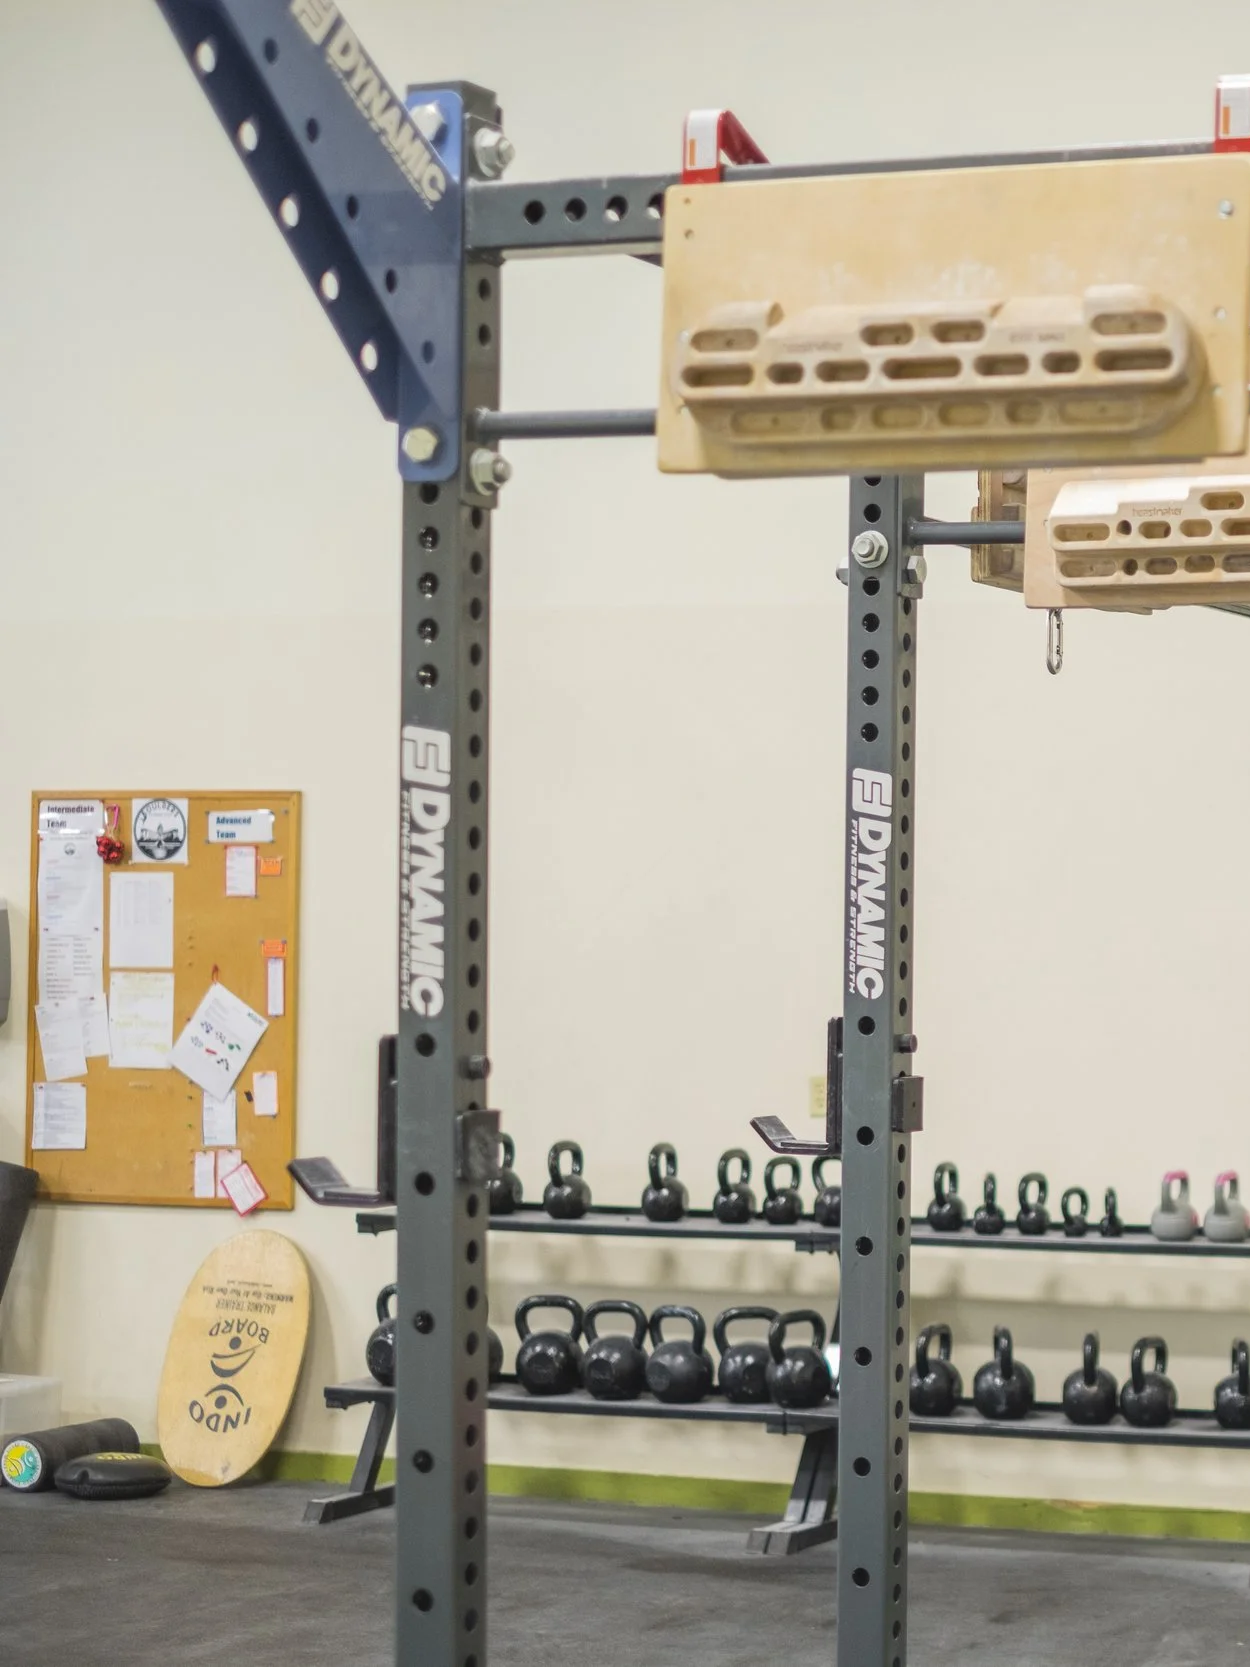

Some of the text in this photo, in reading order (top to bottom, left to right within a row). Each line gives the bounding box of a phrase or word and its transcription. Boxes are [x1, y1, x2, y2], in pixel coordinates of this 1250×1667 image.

[327, 22, 446, 201] DYNAMIC
[47, 805, 95, 814] Intermediate
[215, 816, 252, 825] Advanced
[216, 830, 237, 839] Team
[410, 787, 451, 1017] DYNAMIC
[849, 819, 858, 994] FITNESS & STRENGTH
[856, 817, 892, 1000] DYNAMIC
[208, 1318, 270, 1344] BOARD
[189, 1400, 251, 1433] INDO
